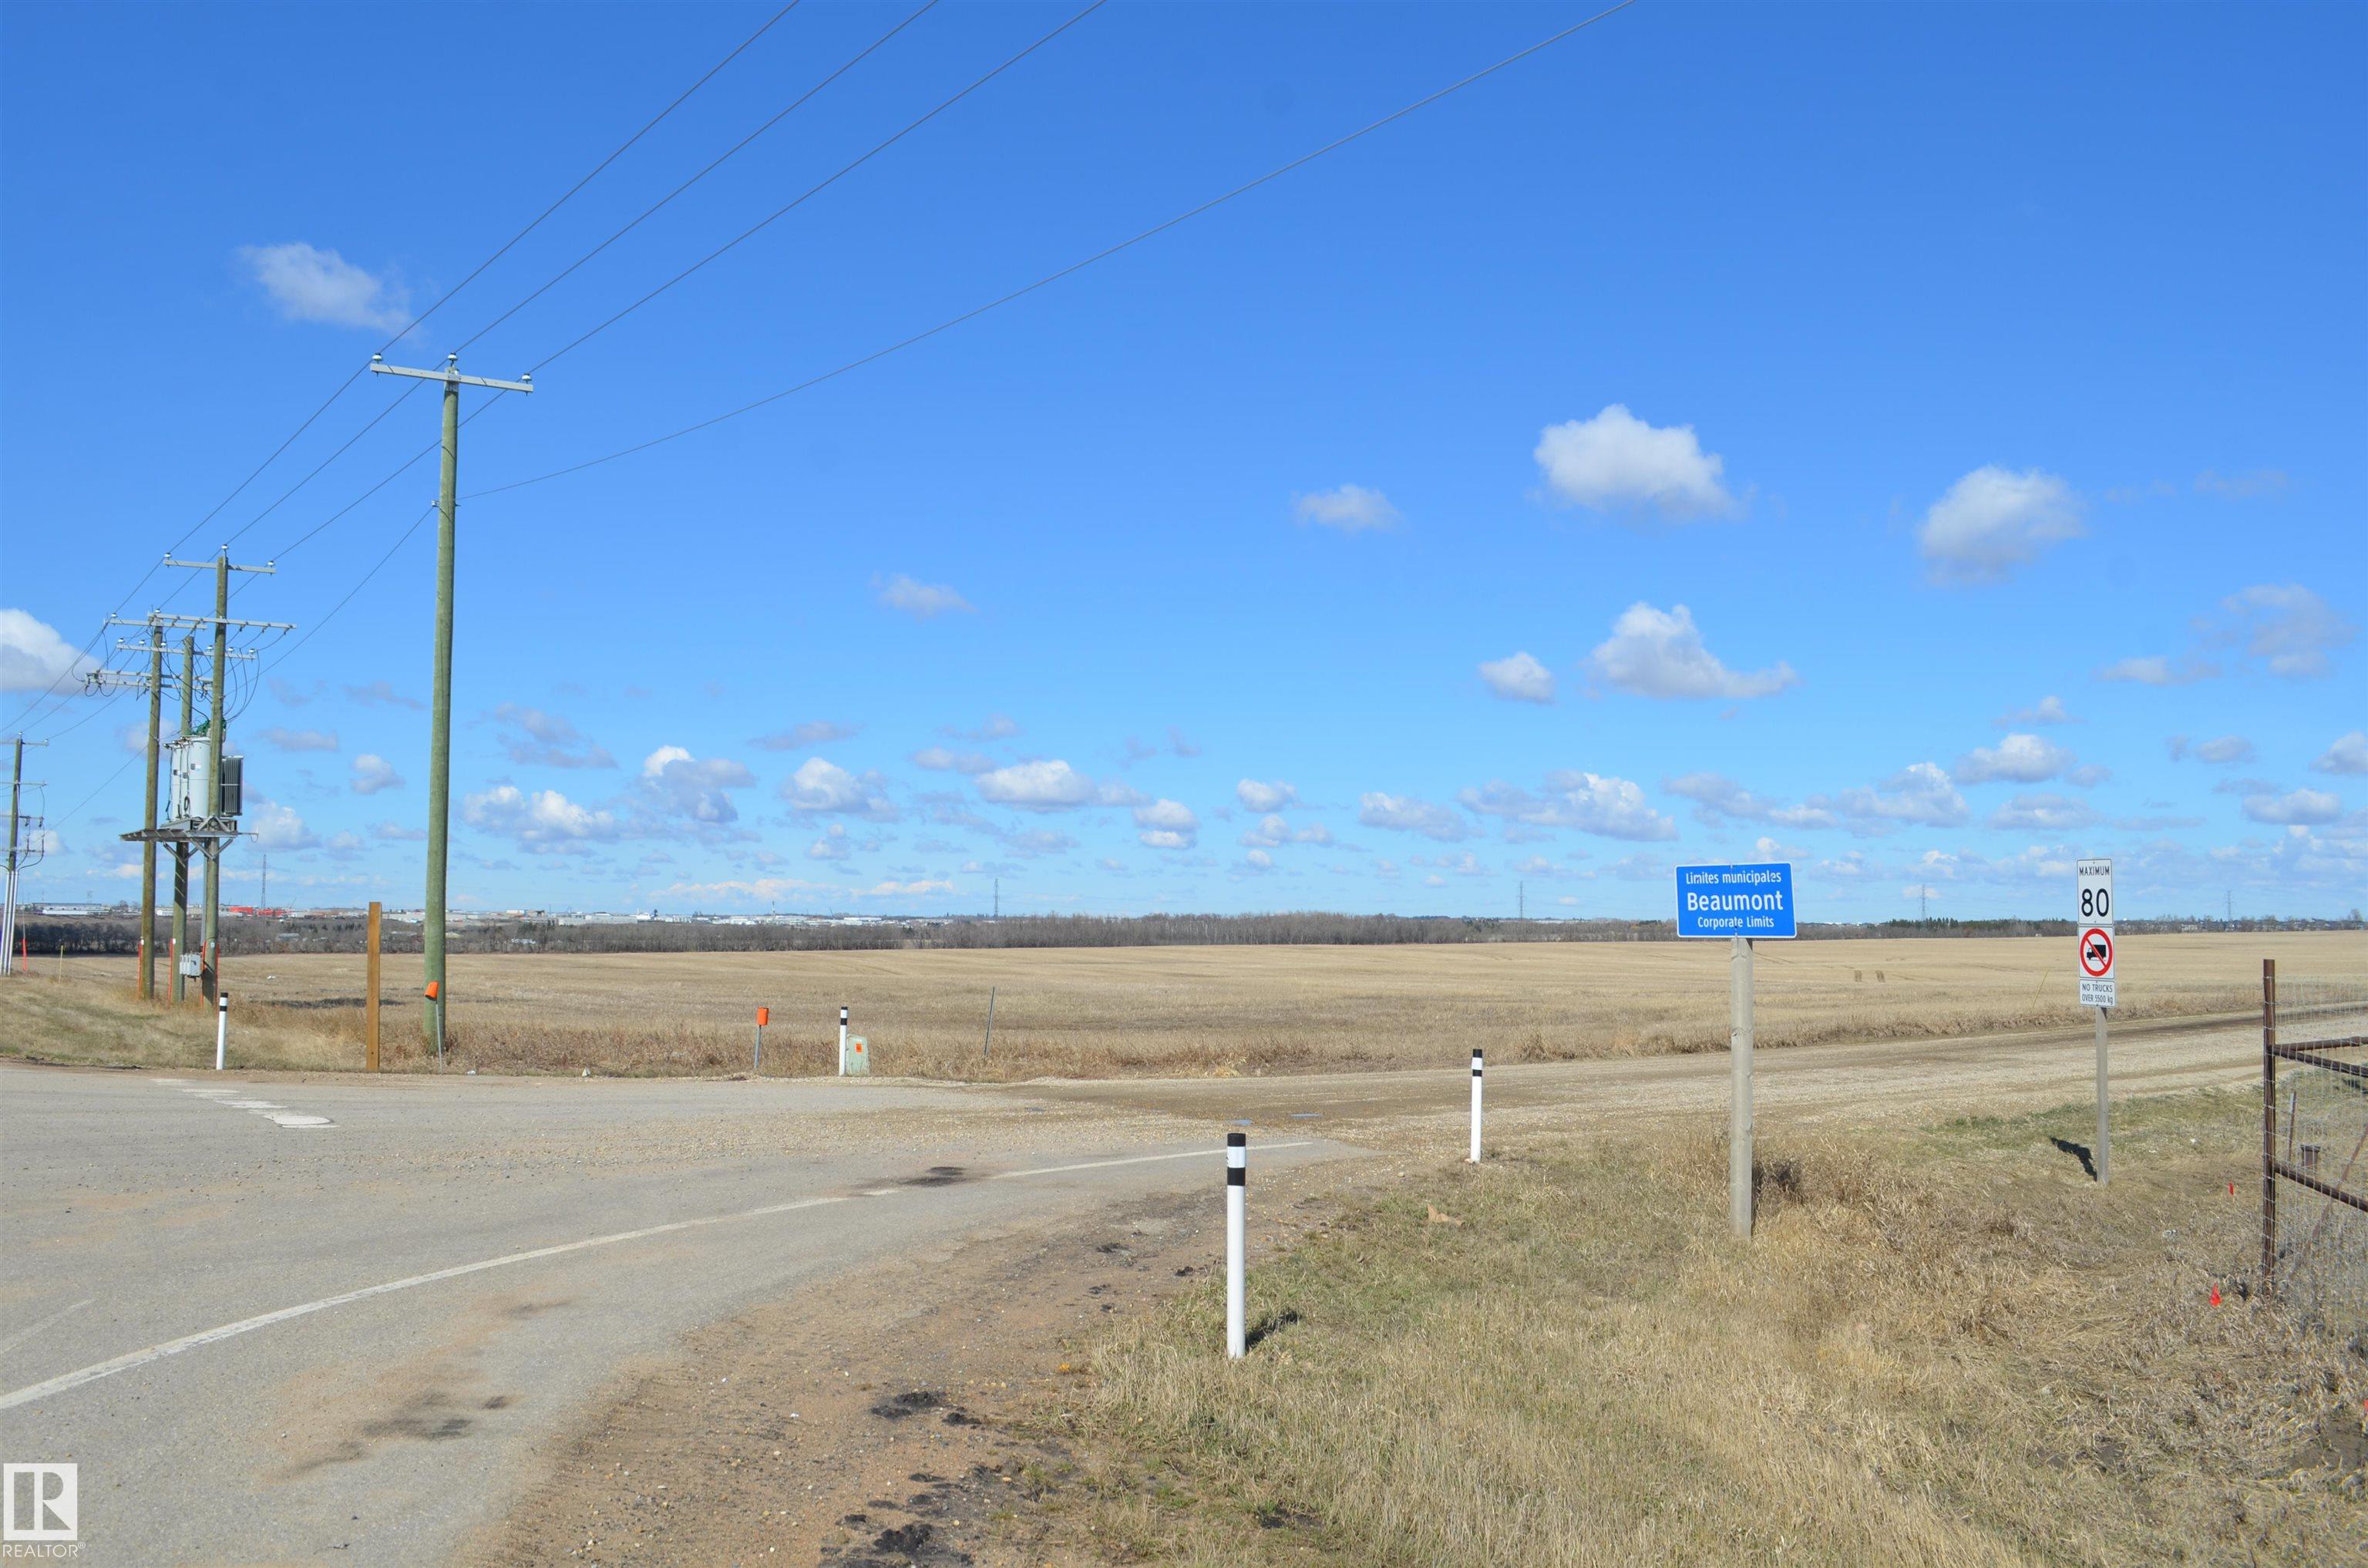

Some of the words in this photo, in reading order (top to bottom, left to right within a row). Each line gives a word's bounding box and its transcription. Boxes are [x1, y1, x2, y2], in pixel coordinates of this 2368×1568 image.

[1686, 872, 1719, 884] Limites
[1723, 870, 1781, 886] municipales
[2079, 866, 2110, 876] MAXIMUM
[1687, 890, 1784, 911] Beaumont
[2081, 888, 2109, 917] 80
[1697, 917, 1743, 930] Corporate
[1747, 916, 1774, 928] Limits
[2082, 983, 2090, 991] NO
[2092, 984, 2113, 993] TRUCKS
[2082, 994, 2094, 1002] OVER
[2107, 995, 2113, 1005] kg
